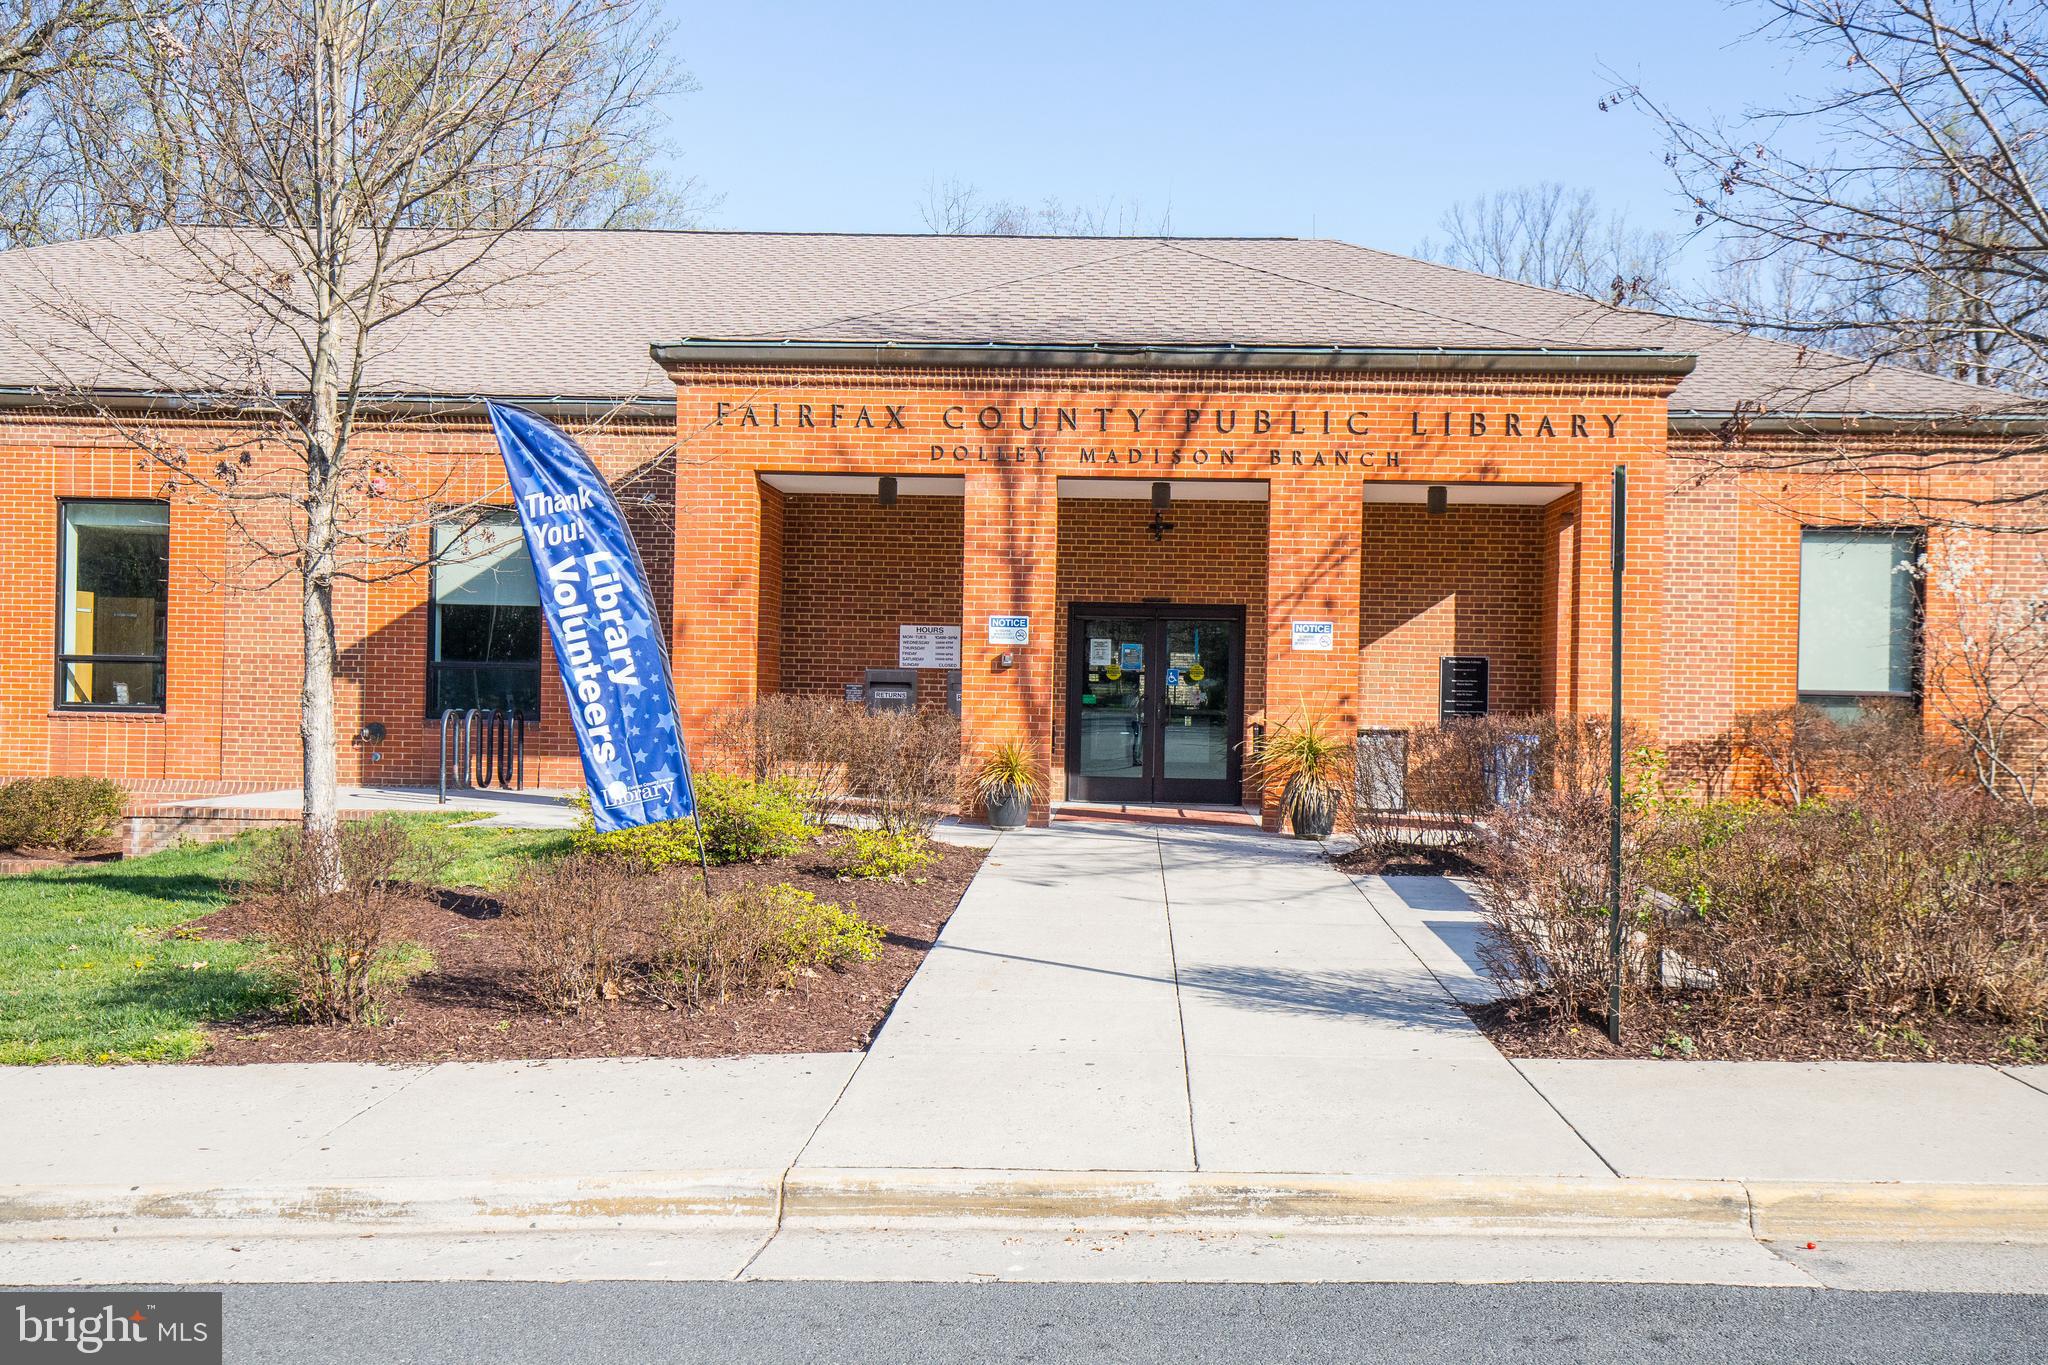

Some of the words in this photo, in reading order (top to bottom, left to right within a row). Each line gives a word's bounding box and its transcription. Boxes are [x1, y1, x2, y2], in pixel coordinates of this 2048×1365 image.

[715, 401, 906, 430] FAIRFAX
[942, 405, 1150, 433] COUNTY
[1184, 408, 1370, 435] PUBLIC
[1410, 410, 1625, 439] LIBRARY
[930, 444, 1047, 463] DOLLEY
[1079, 446, 1235, 466] MADISON
[1269, 450, 1401, 468] BRANCH
[524, 486, 595, 519] Thank
[532, 517, 585, 550] You!
[583, 551, 641, 687] Library
[992, 618, 1026, 627] NOTICE
[1295, 624, 1330, 633] NOTICE
[548, 555, 616, 766] Volunteers
[875, 691, 907, 699] RETURNS
[600, 781, 675, 808] Library
